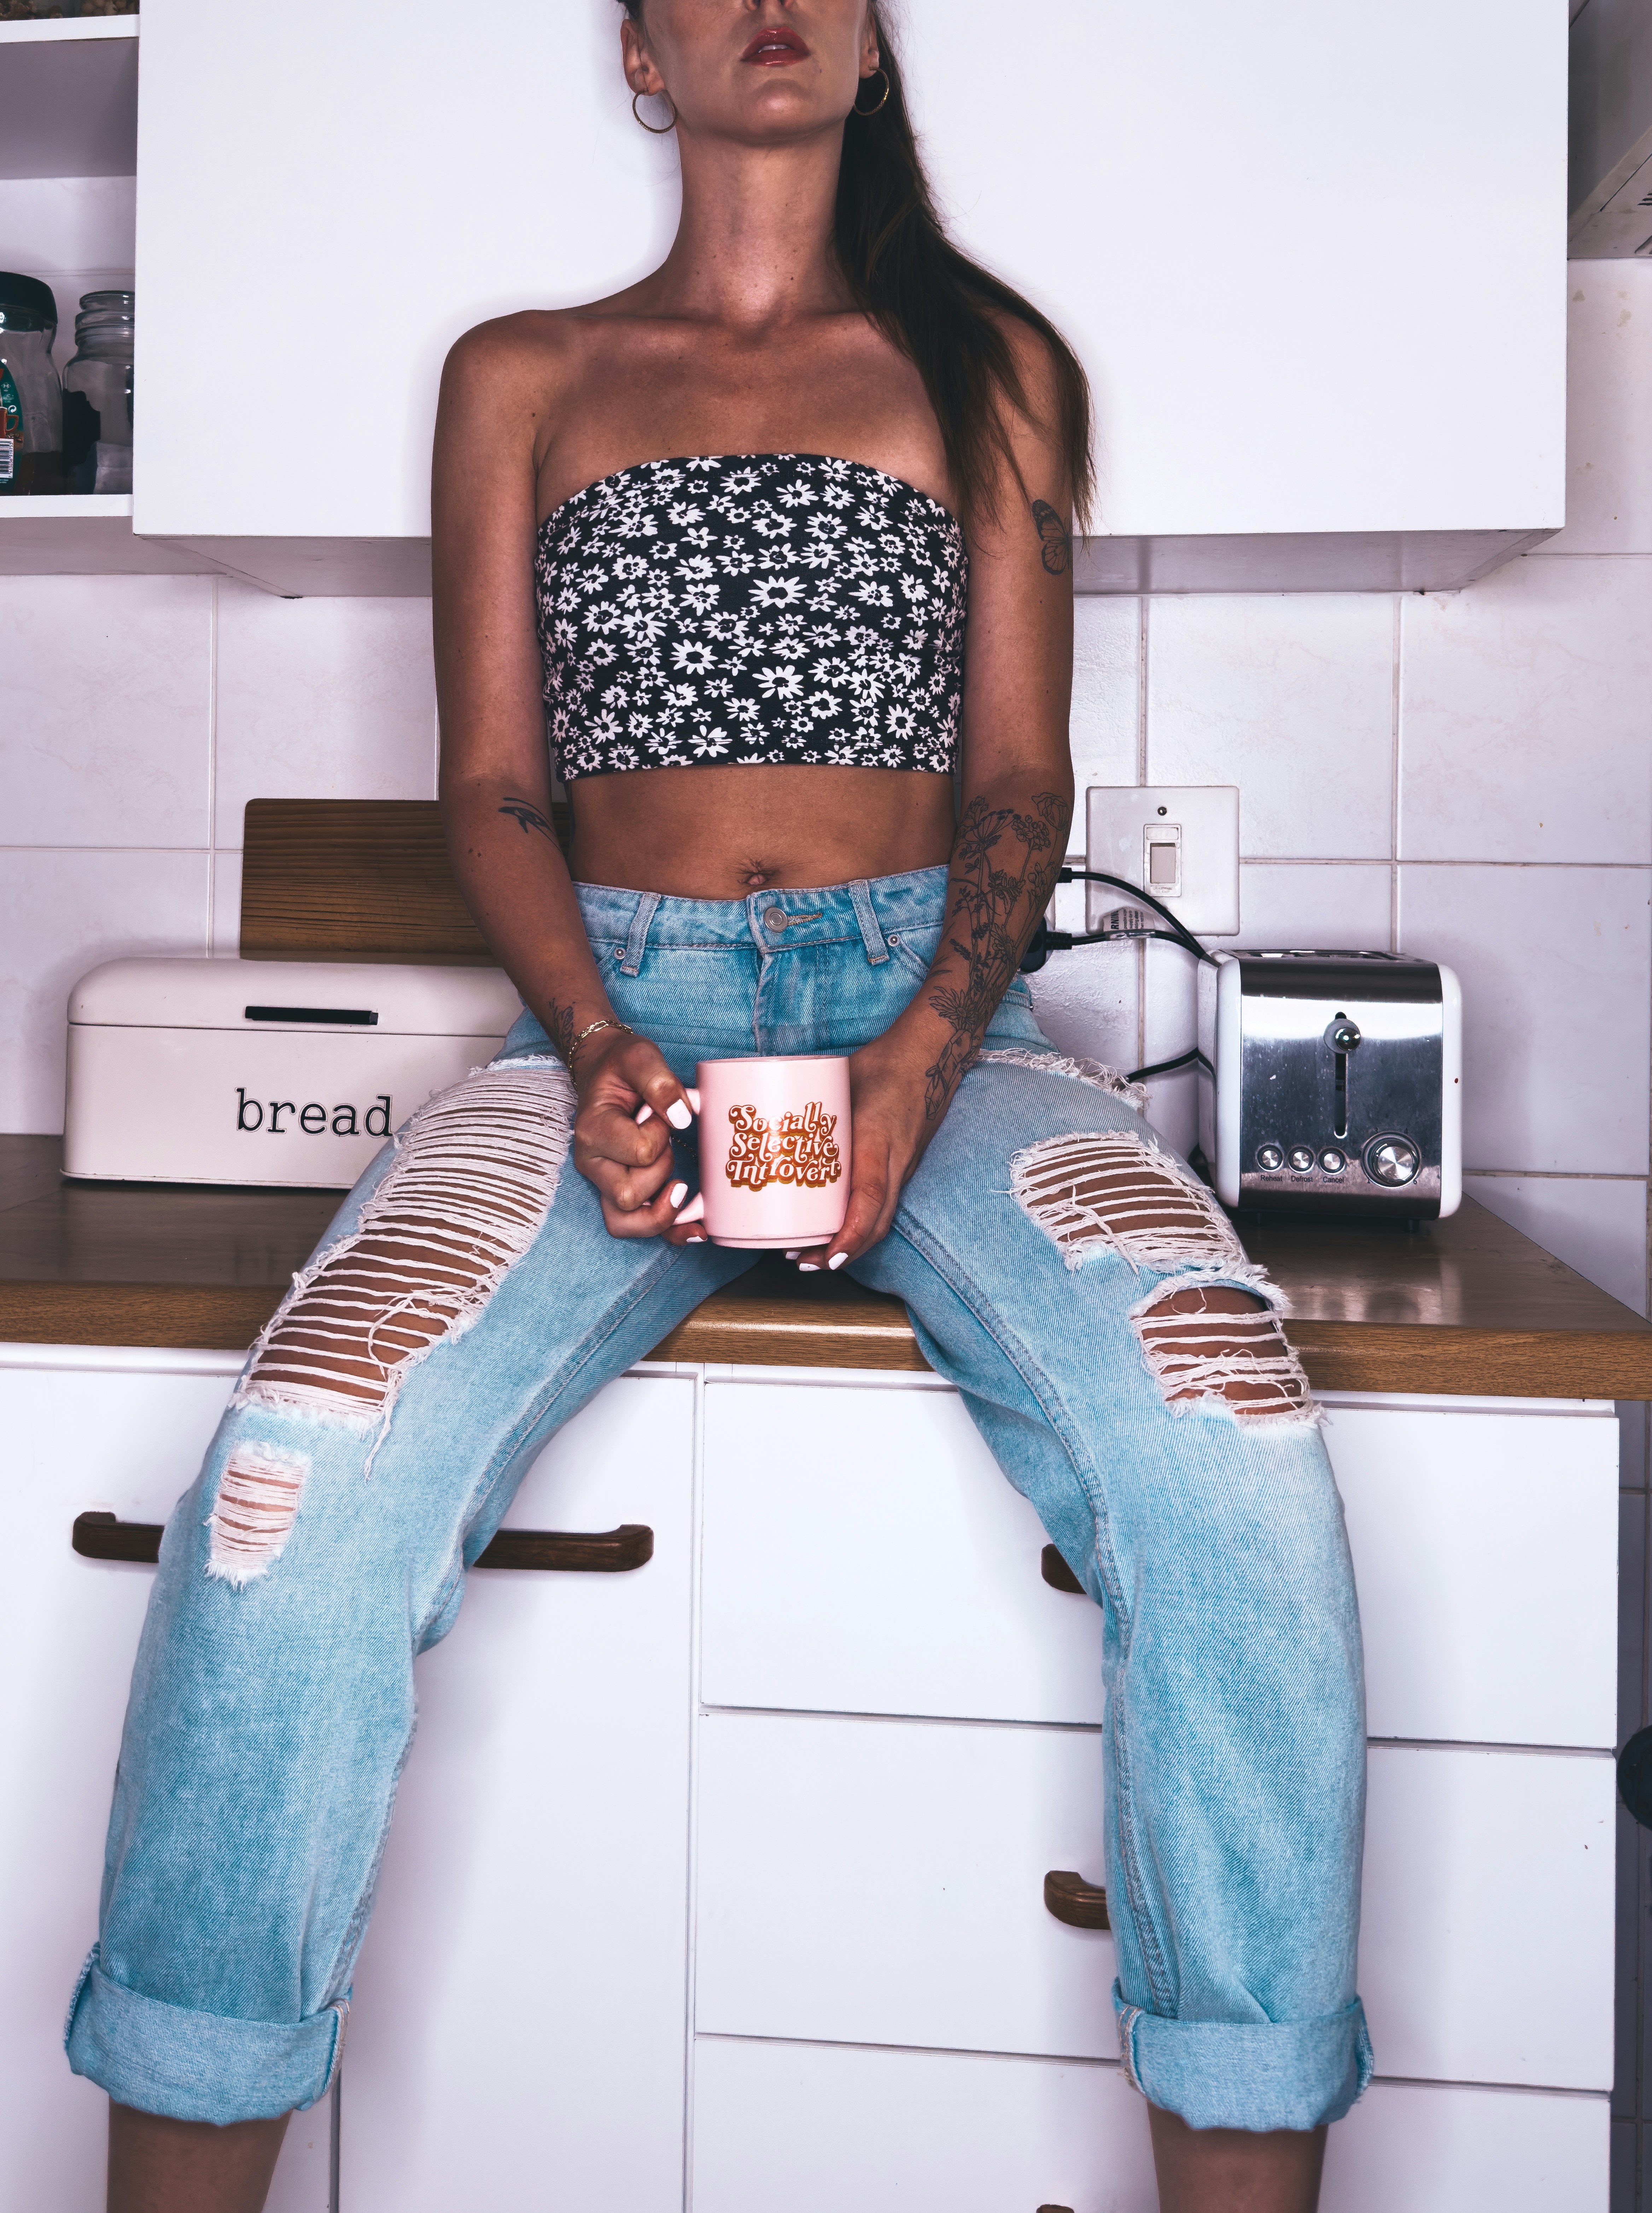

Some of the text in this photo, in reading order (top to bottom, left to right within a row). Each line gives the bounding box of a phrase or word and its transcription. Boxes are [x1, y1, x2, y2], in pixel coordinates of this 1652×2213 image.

[235, 1087, 393, 1138] bread
[729, 1102, 837, 1136] Socially
[729, 1132, 839, 1164] Selective
[726, 1153, 841, 1190] Introvert
